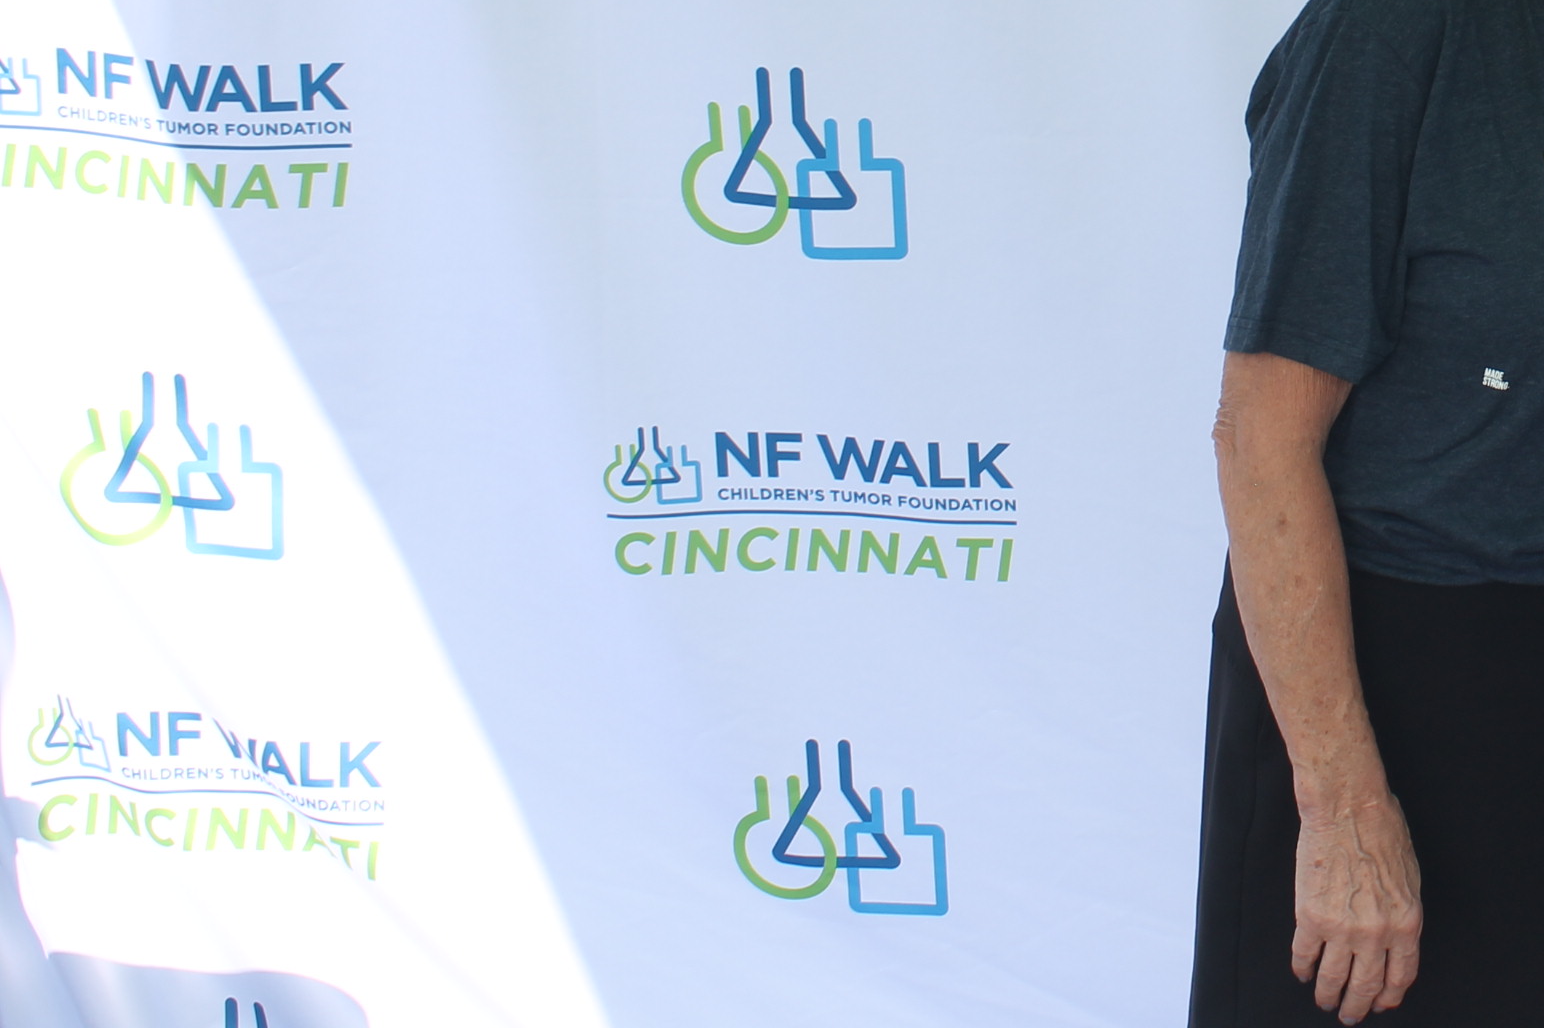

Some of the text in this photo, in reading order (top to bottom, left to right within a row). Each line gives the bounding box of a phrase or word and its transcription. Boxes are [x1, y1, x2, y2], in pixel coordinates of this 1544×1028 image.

[56, 47, 349, 113] NF WALK
[58, 106, 352, 137] CHILDREN'S TUMOR FOUNDATION
[1, 143, 349, 209] INCINNATI
[715, 431, 1014, 489] NF WALK
[717, 488, 1017, 513] CHILDREN'S TUMOR FOUNDATION
[614, 527, 1014, 583] CINCINNATI
[117, 711, 382, 788] NF WALK
[122, 767, 224, 781] CHILDREN'S
[38, 792, 380, 881] CINCINNATI
